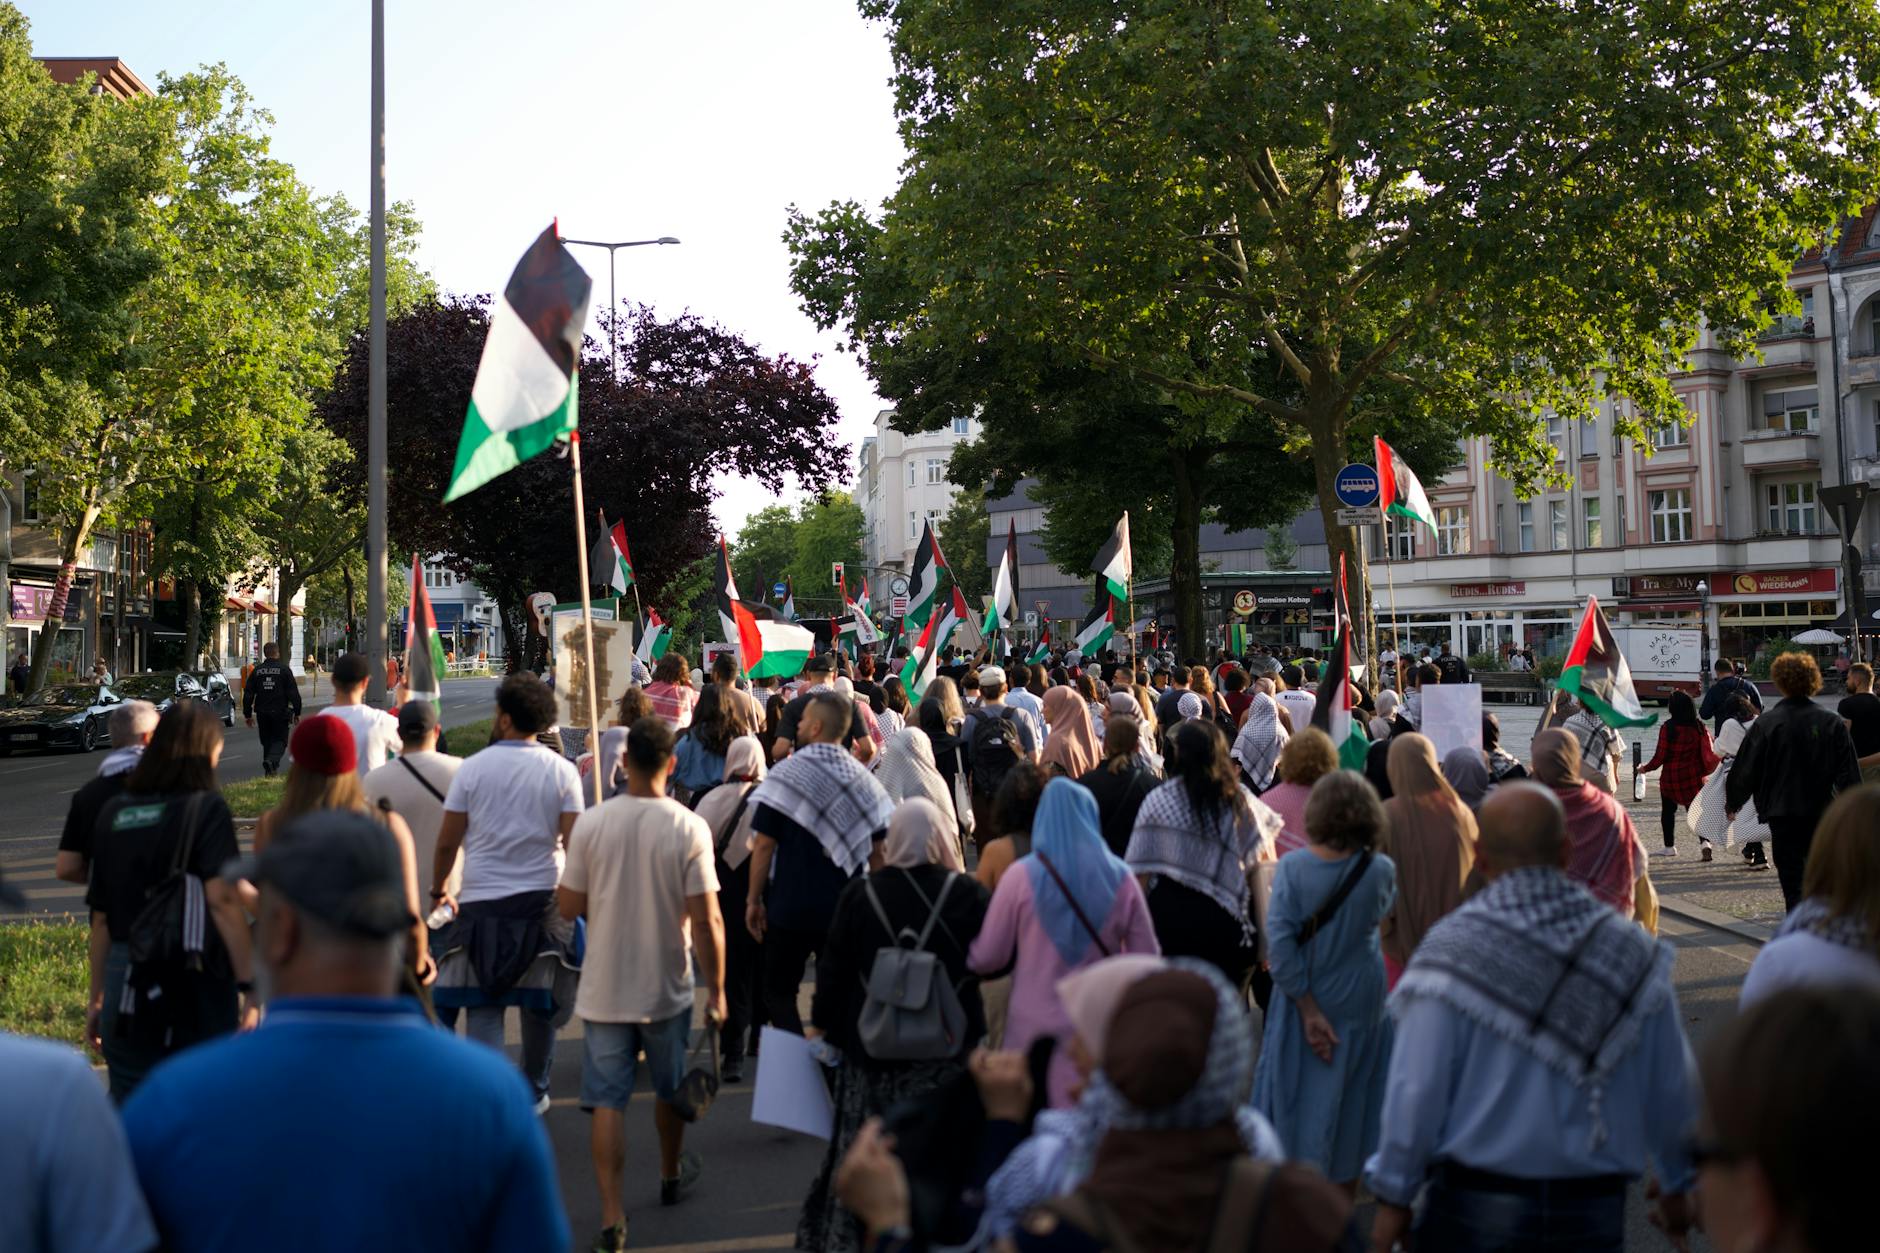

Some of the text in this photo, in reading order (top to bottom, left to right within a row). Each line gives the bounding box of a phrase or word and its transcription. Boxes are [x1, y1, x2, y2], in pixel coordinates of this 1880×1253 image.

[1641, 577, 1694, 590] Tra My
[1760, 577, 1809, 590] WIEDEMANN
[1236, 594, 1253, 607] 63
[1287, 596, 1311, 604] Kebap
[1649, 633, 1680, 649] MARKT
[1651, 653, 1681, 668] BISTRO
